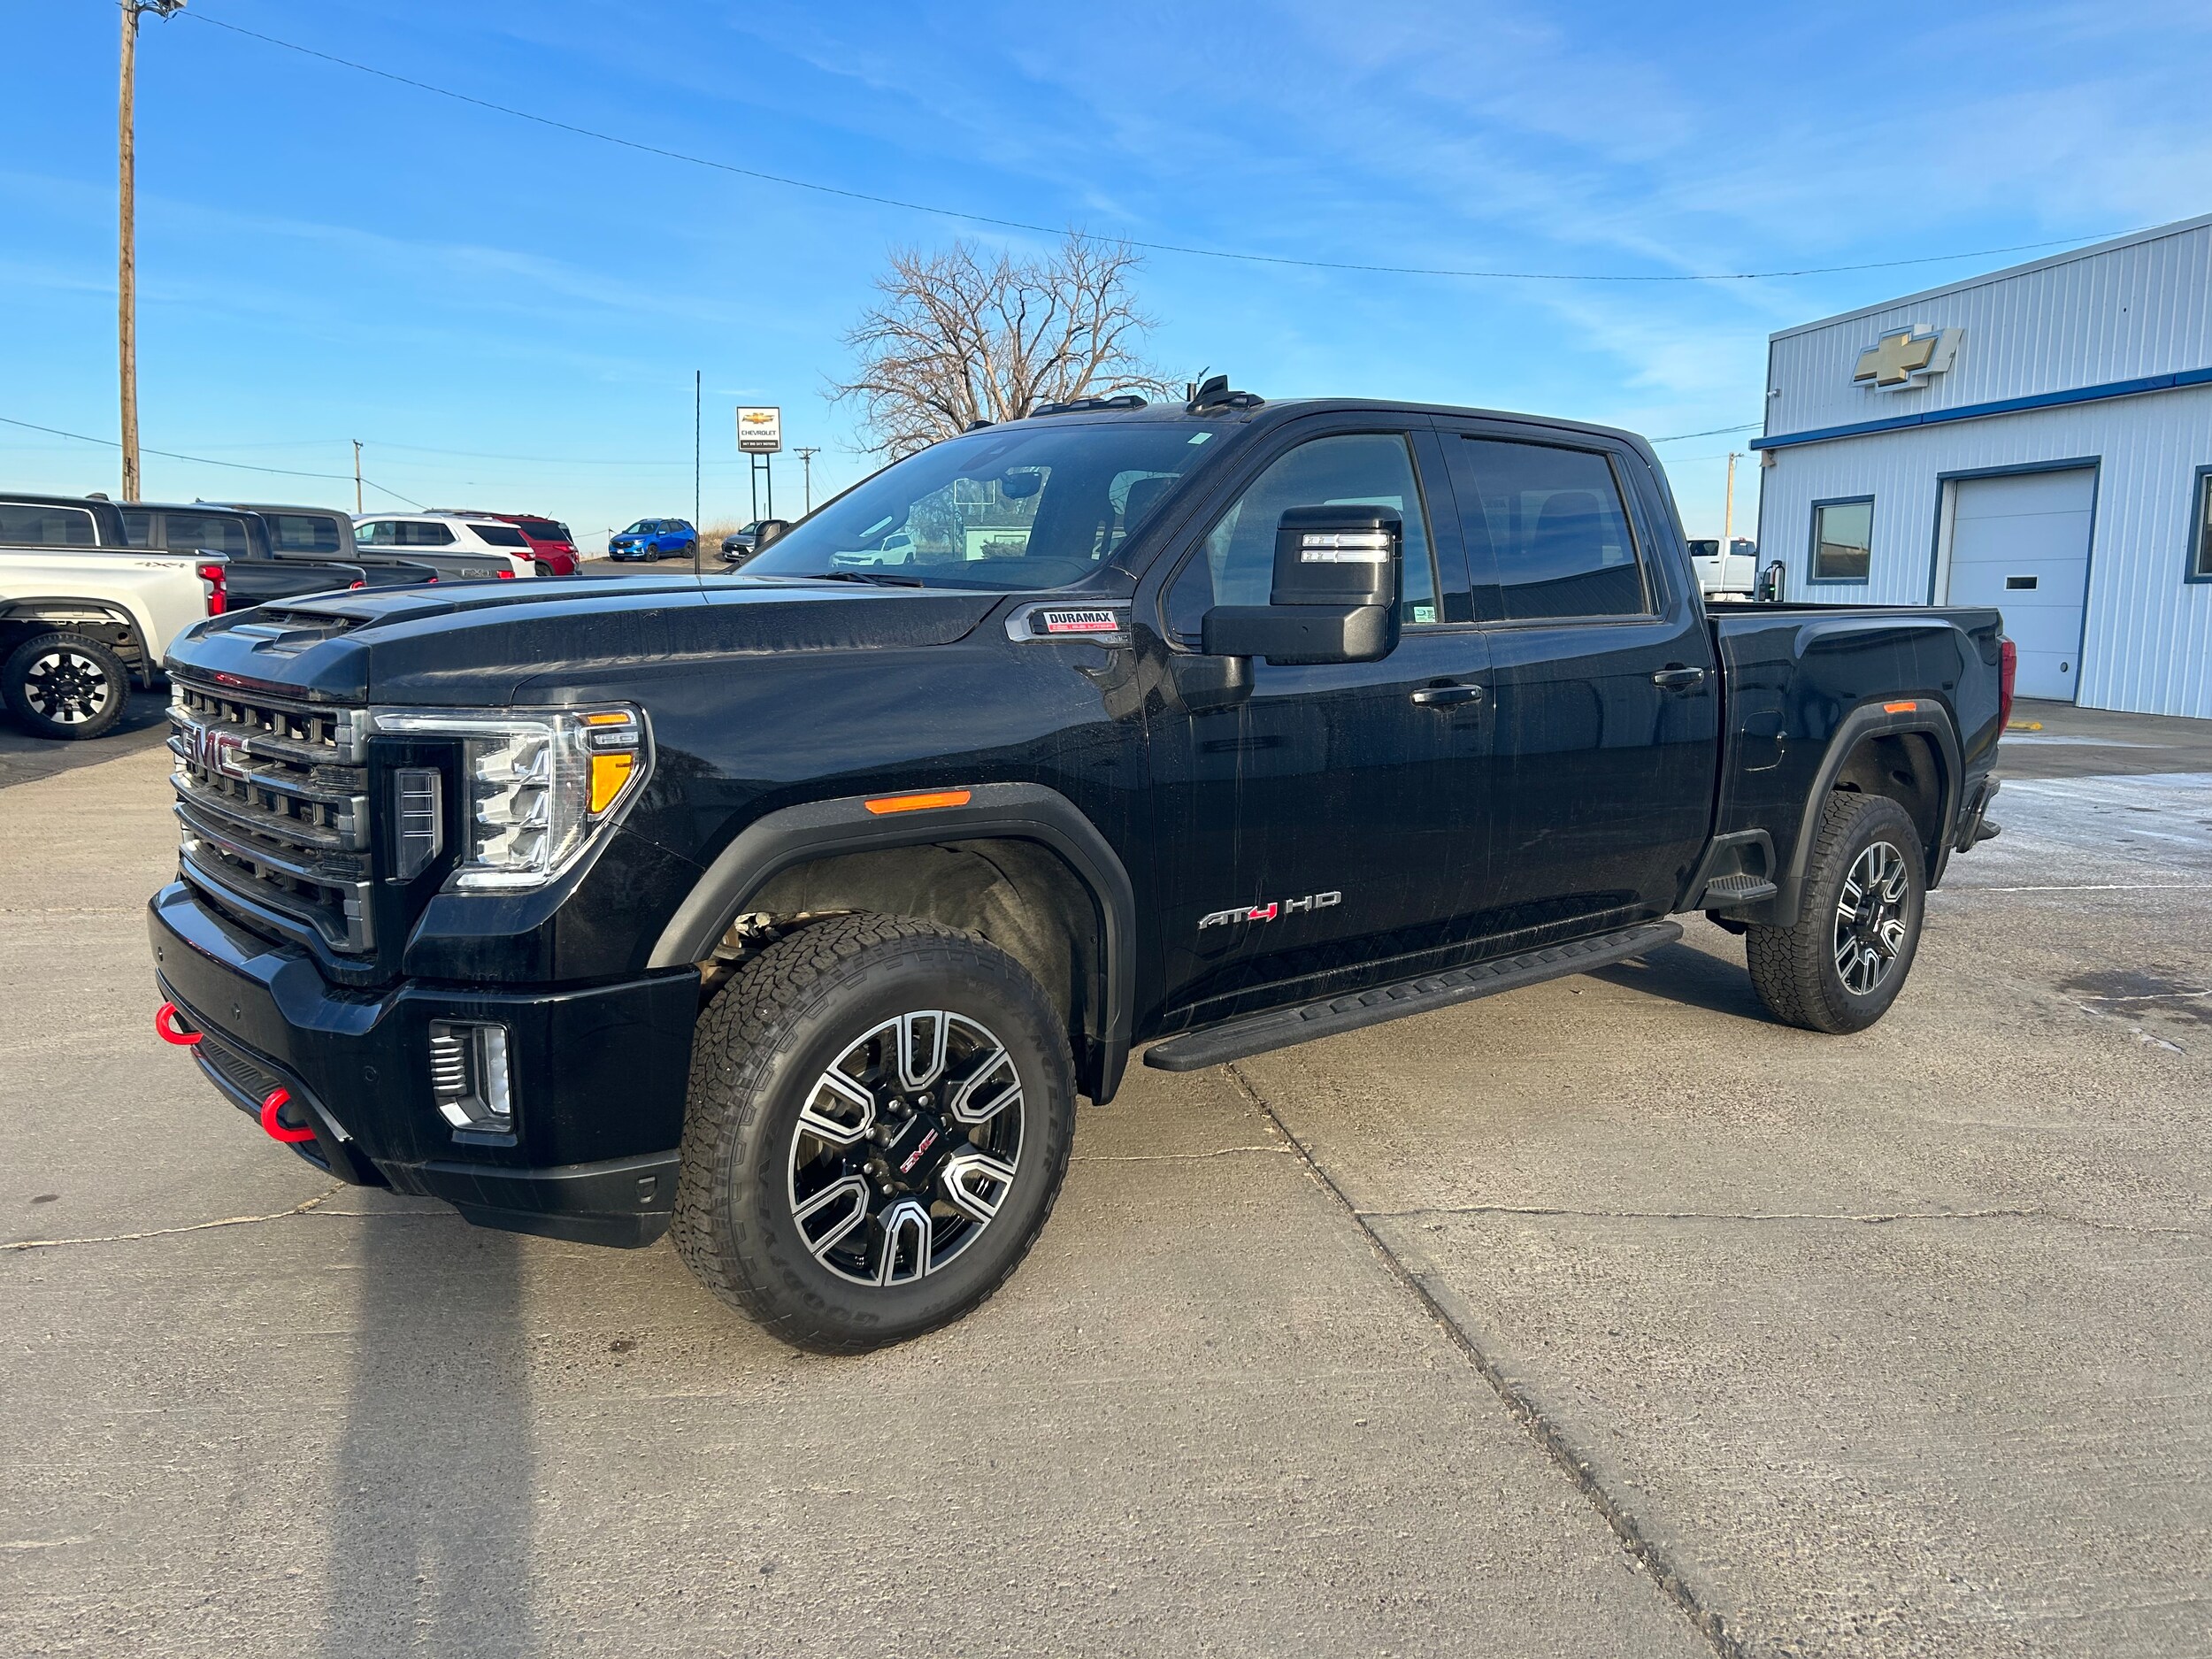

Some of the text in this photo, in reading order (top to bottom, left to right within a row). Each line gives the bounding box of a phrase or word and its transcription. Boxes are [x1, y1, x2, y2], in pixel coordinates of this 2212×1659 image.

[1048, 613, 1112, 624] DURAMAX
[182, 719, 252, 784] GMC
[1197, 890, 1342, 930] AT4 HD
[900, 1128, 939, 1173] GMC
